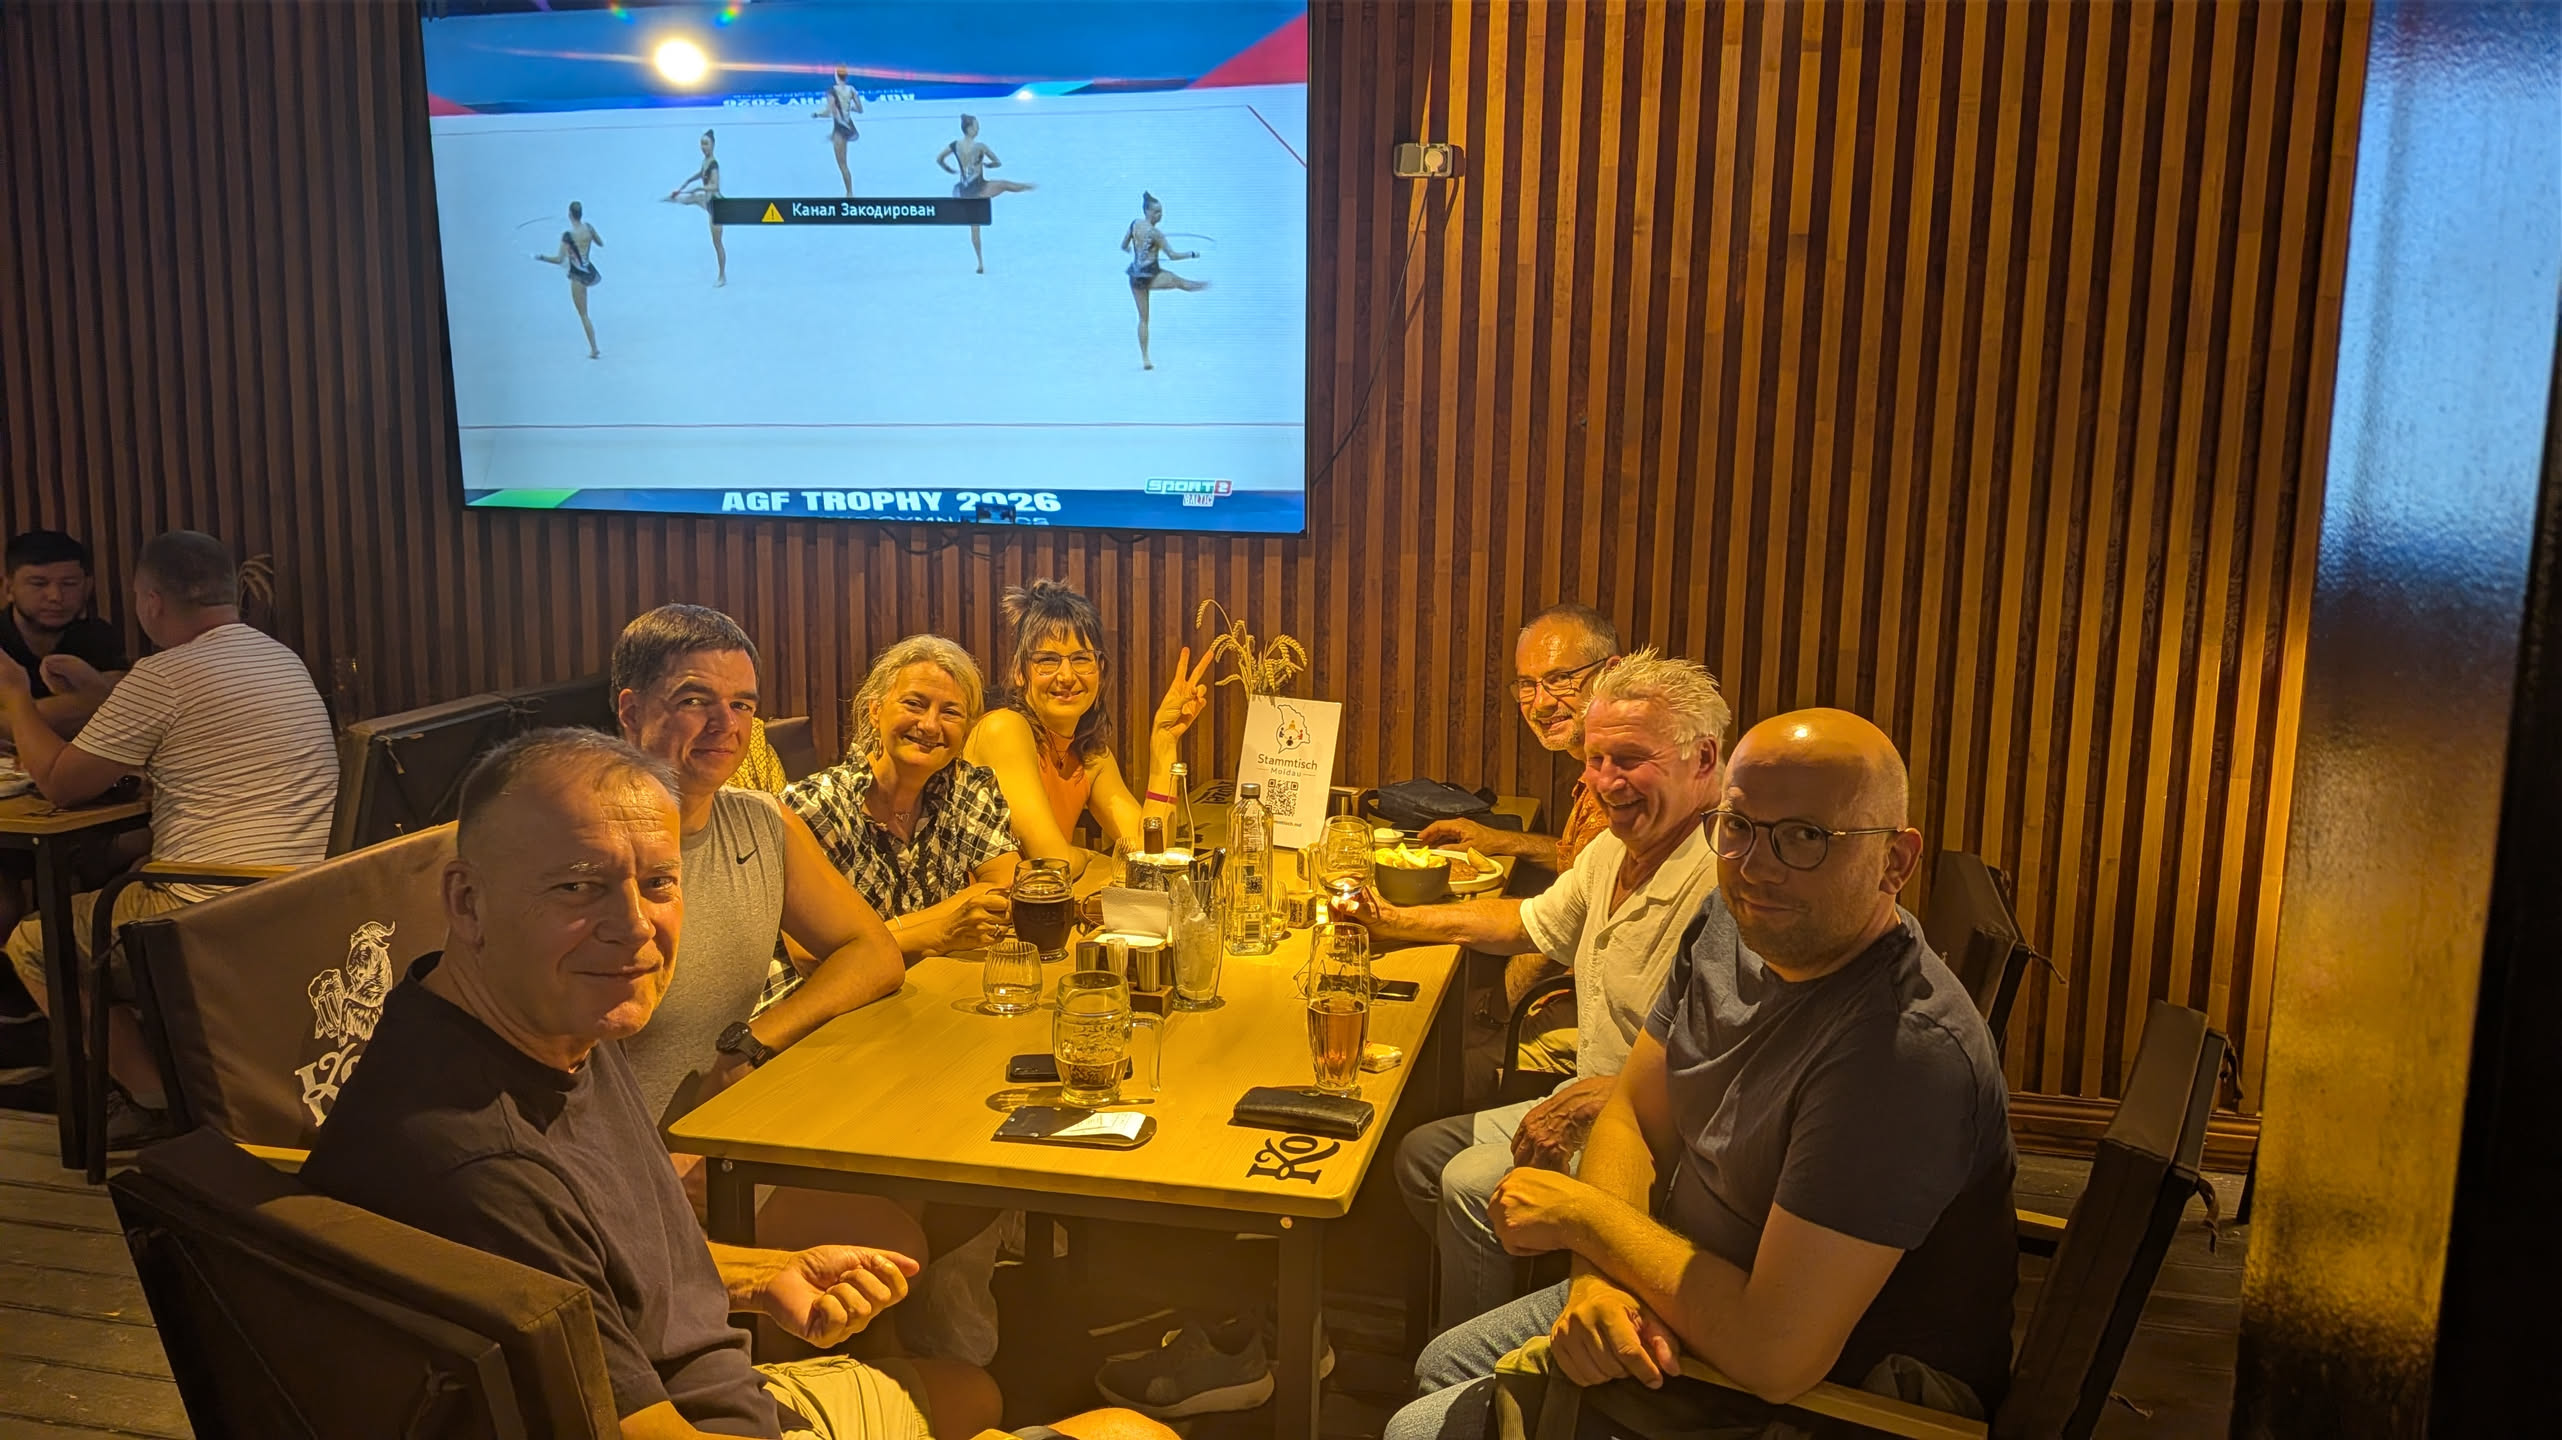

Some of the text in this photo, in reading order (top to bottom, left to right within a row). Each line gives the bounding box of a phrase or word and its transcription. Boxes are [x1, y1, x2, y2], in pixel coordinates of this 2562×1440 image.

[792, 202, 936, 219] Канал Закодирован
[722, 491, 1062, 512] AGF TROPHY 2026
[1257, 753, 1318, 771] Stammtisch
[1270, 767, 1302, 777] Moldau
[1245, 1135, 1341, 1184] Ko
